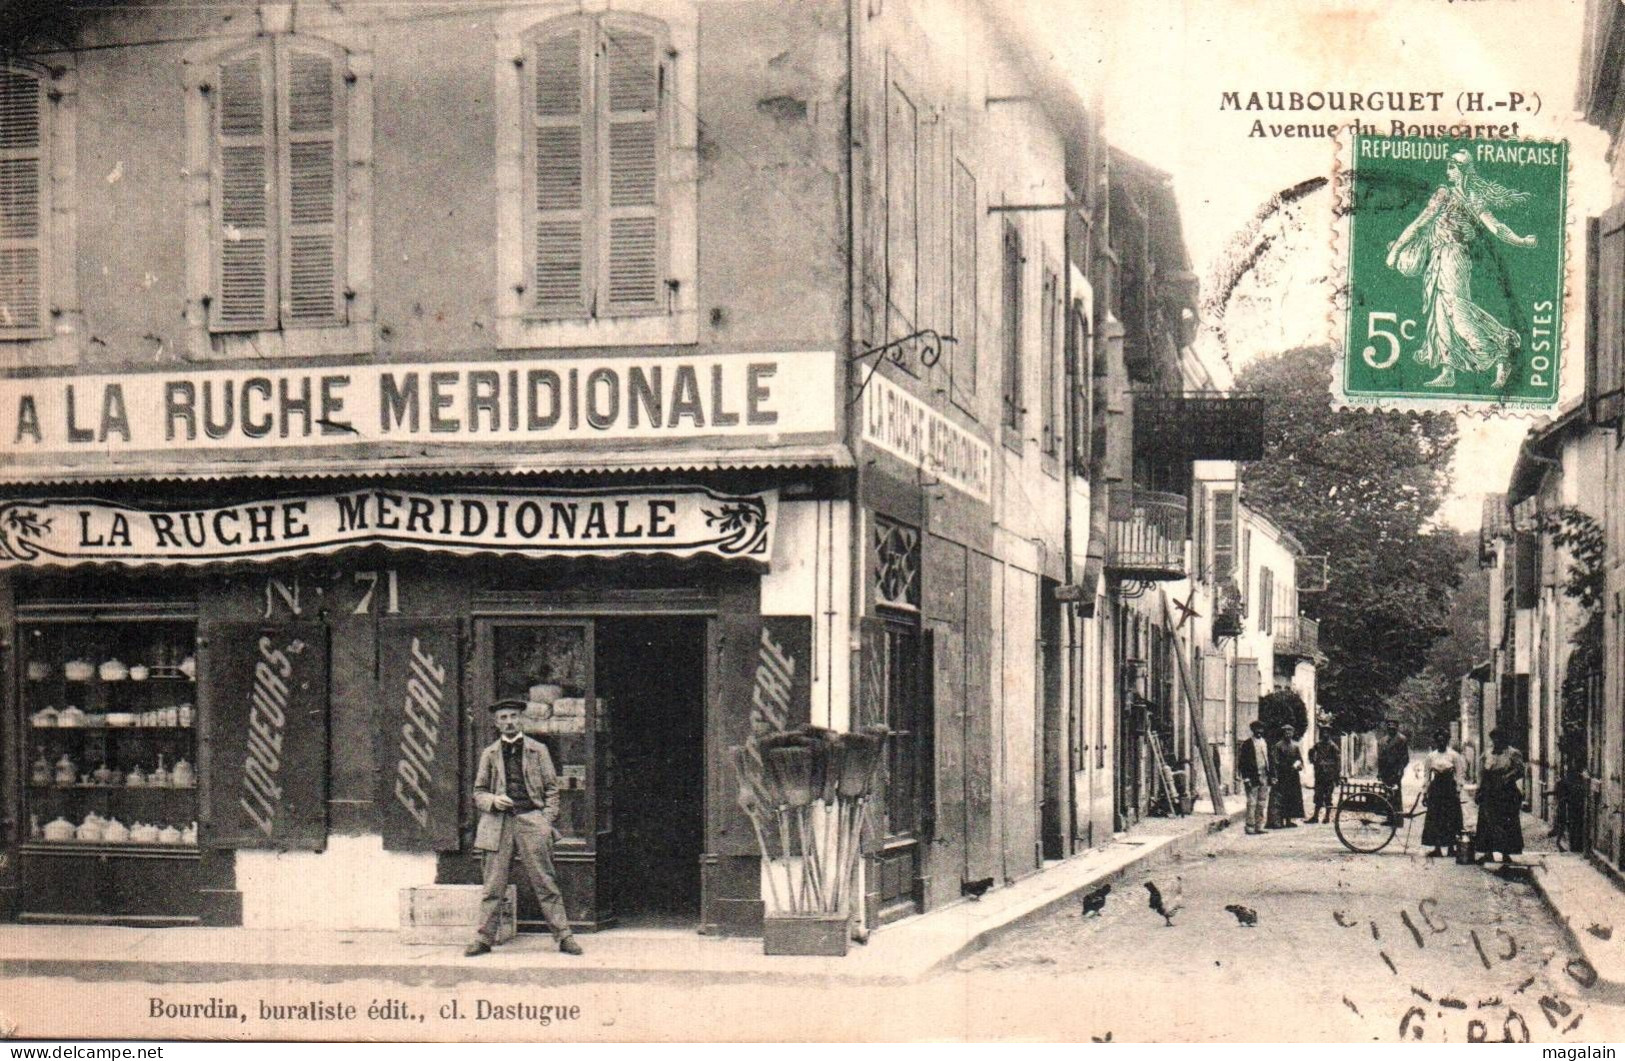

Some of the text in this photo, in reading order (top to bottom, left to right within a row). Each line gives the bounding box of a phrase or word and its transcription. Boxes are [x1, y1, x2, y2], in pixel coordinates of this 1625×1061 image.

[1476, 144, 1558, 167] FRANÇAISE
[1530, 300, 1553, 387] POSTES
[14, 363, 779, 444] A LA RUCHE MERIDIONALE
[79, 494, 676, 547] LA RUCHE MERIDIONALE
[352, 570, 402, 615] 71
[394, 637, 445, 827] EPICERIE
